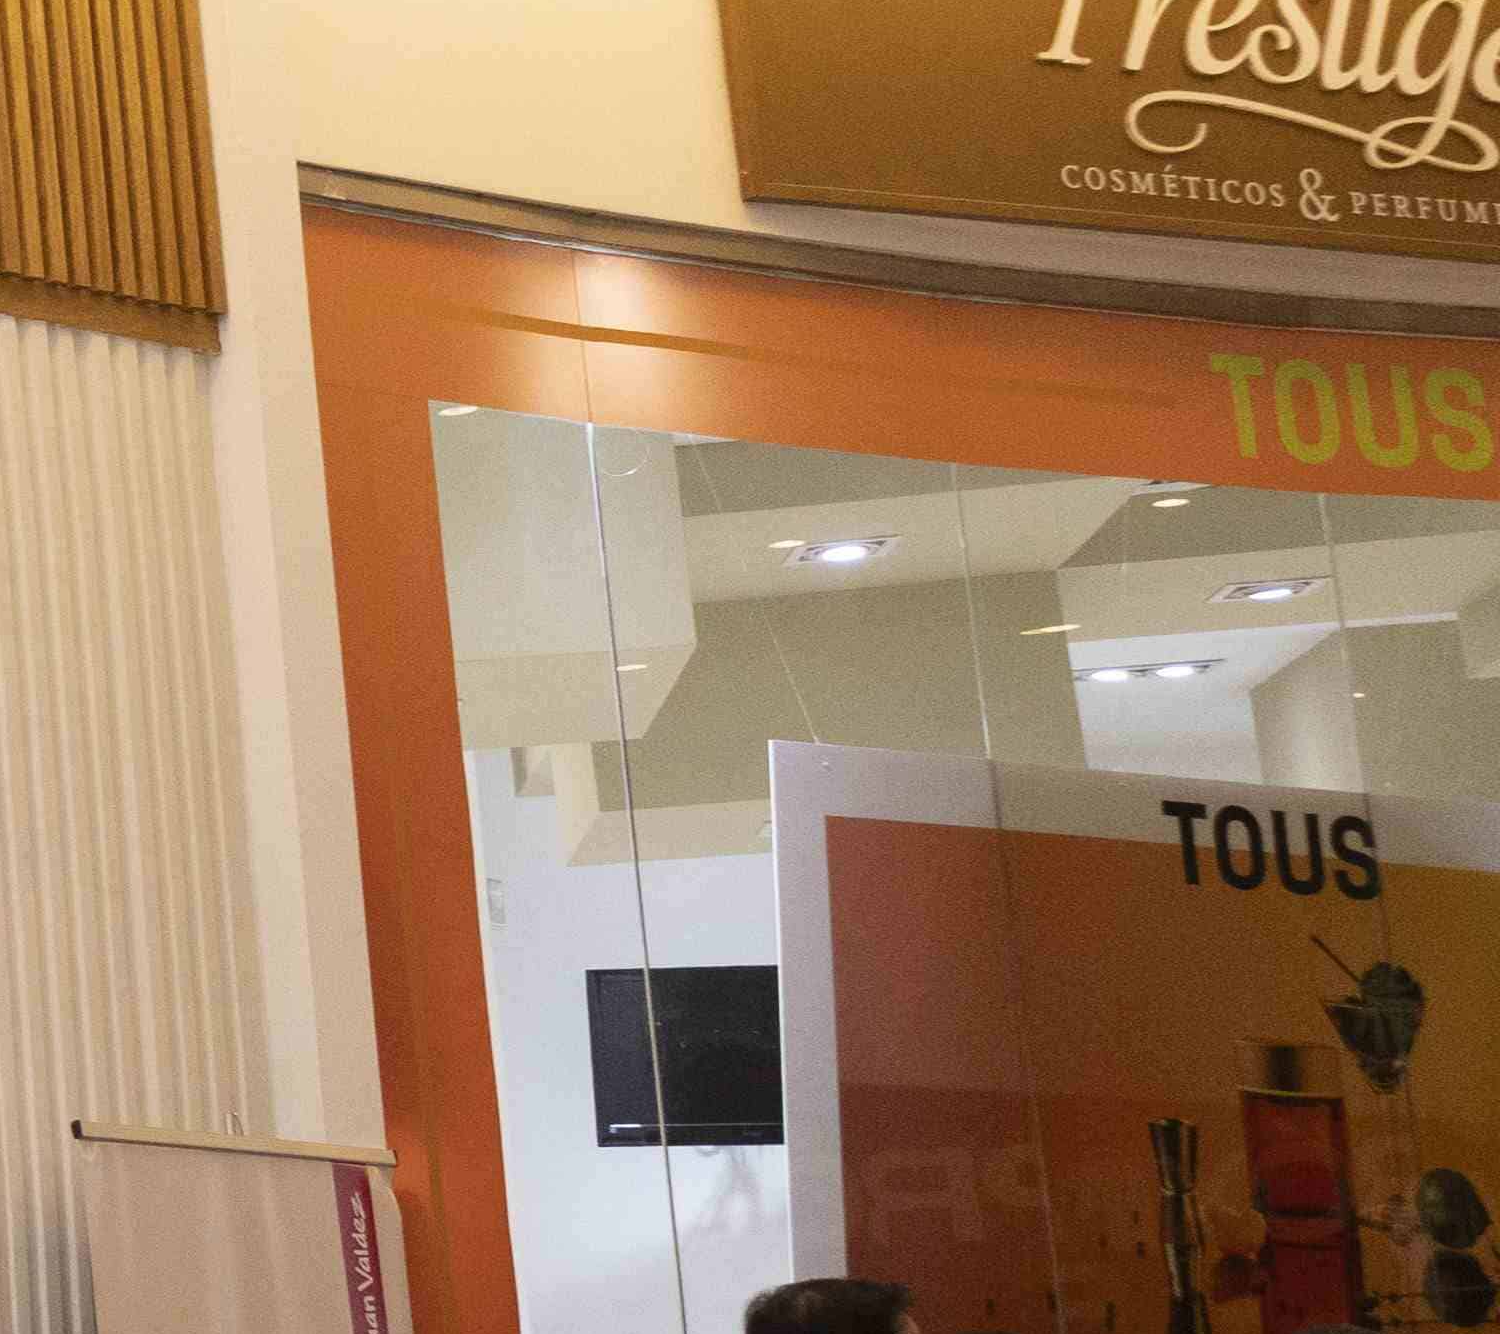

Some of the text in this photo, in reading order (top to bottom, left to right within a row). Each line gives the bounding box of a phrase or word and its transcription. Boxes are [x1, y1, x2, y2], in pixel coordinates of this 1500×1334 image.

[1061, 164, 1286, 208] COSMÉTICOS
[1299, 167, 1339, 222] &
[1209, 350, 1496, 474] TOUS
[1161, 800, 1382, 901] TOUS
[350, 1192, 374, 1293] Valdez
